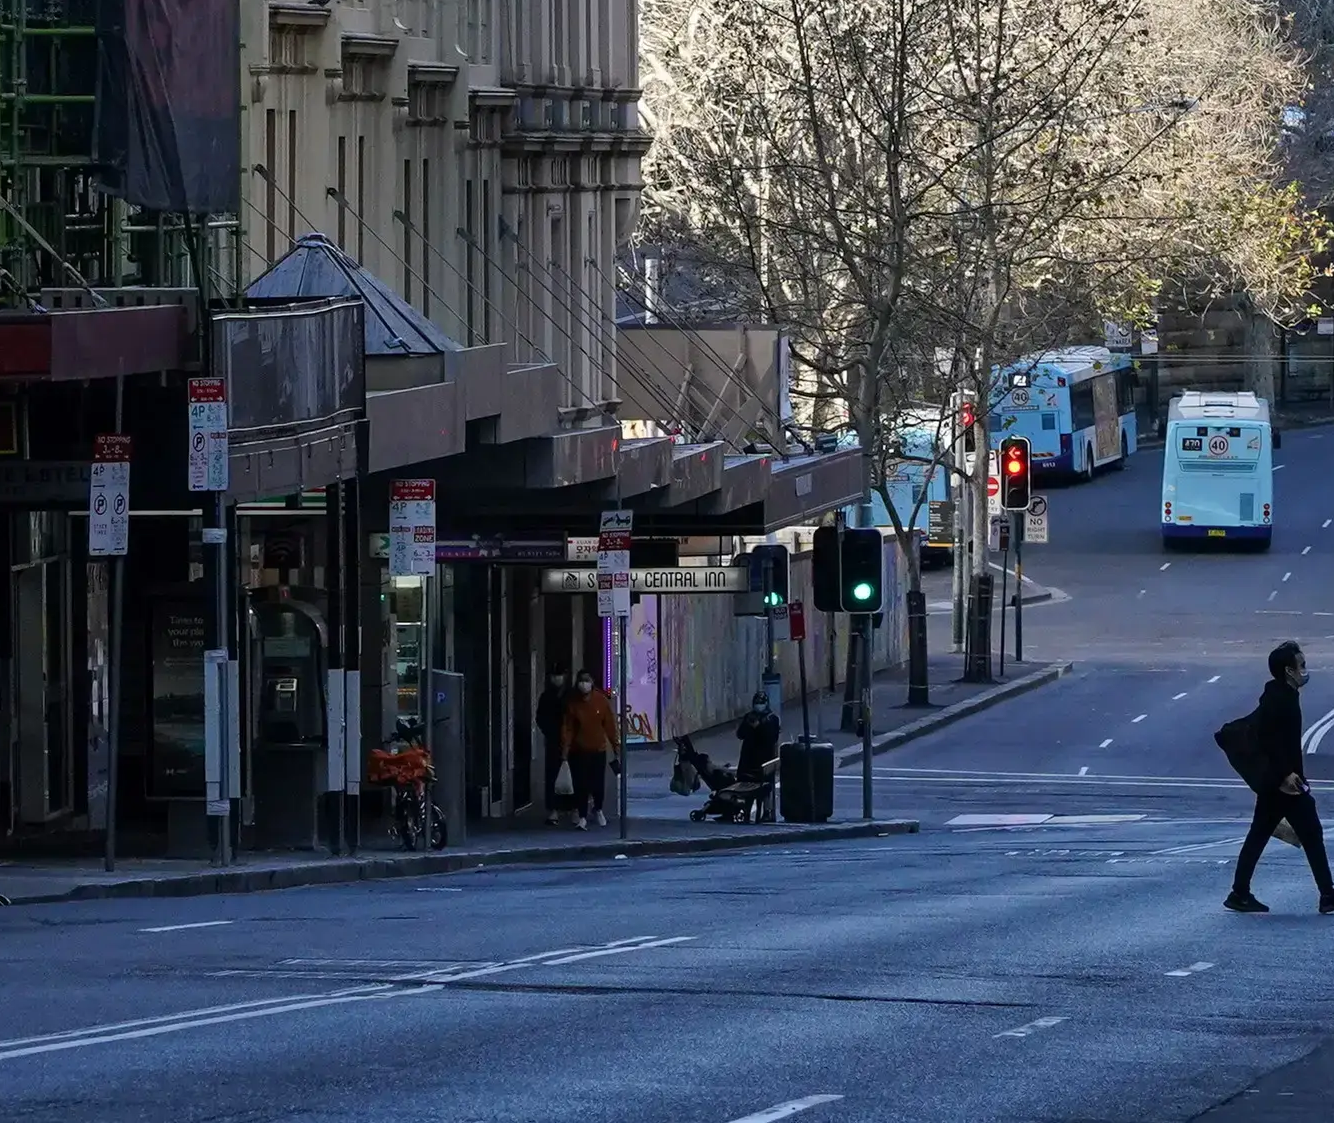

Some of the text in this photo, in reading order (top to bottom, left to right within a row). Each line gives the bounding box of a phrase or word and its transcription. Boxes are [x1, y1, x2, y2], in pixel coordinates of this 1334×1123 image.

[1212, 441, 1225, 450] 40
[1030, 518, 1043, 526] NO
[645, 572, 697, 588] CENTRAL
[705, 572, 726, 587] INN
